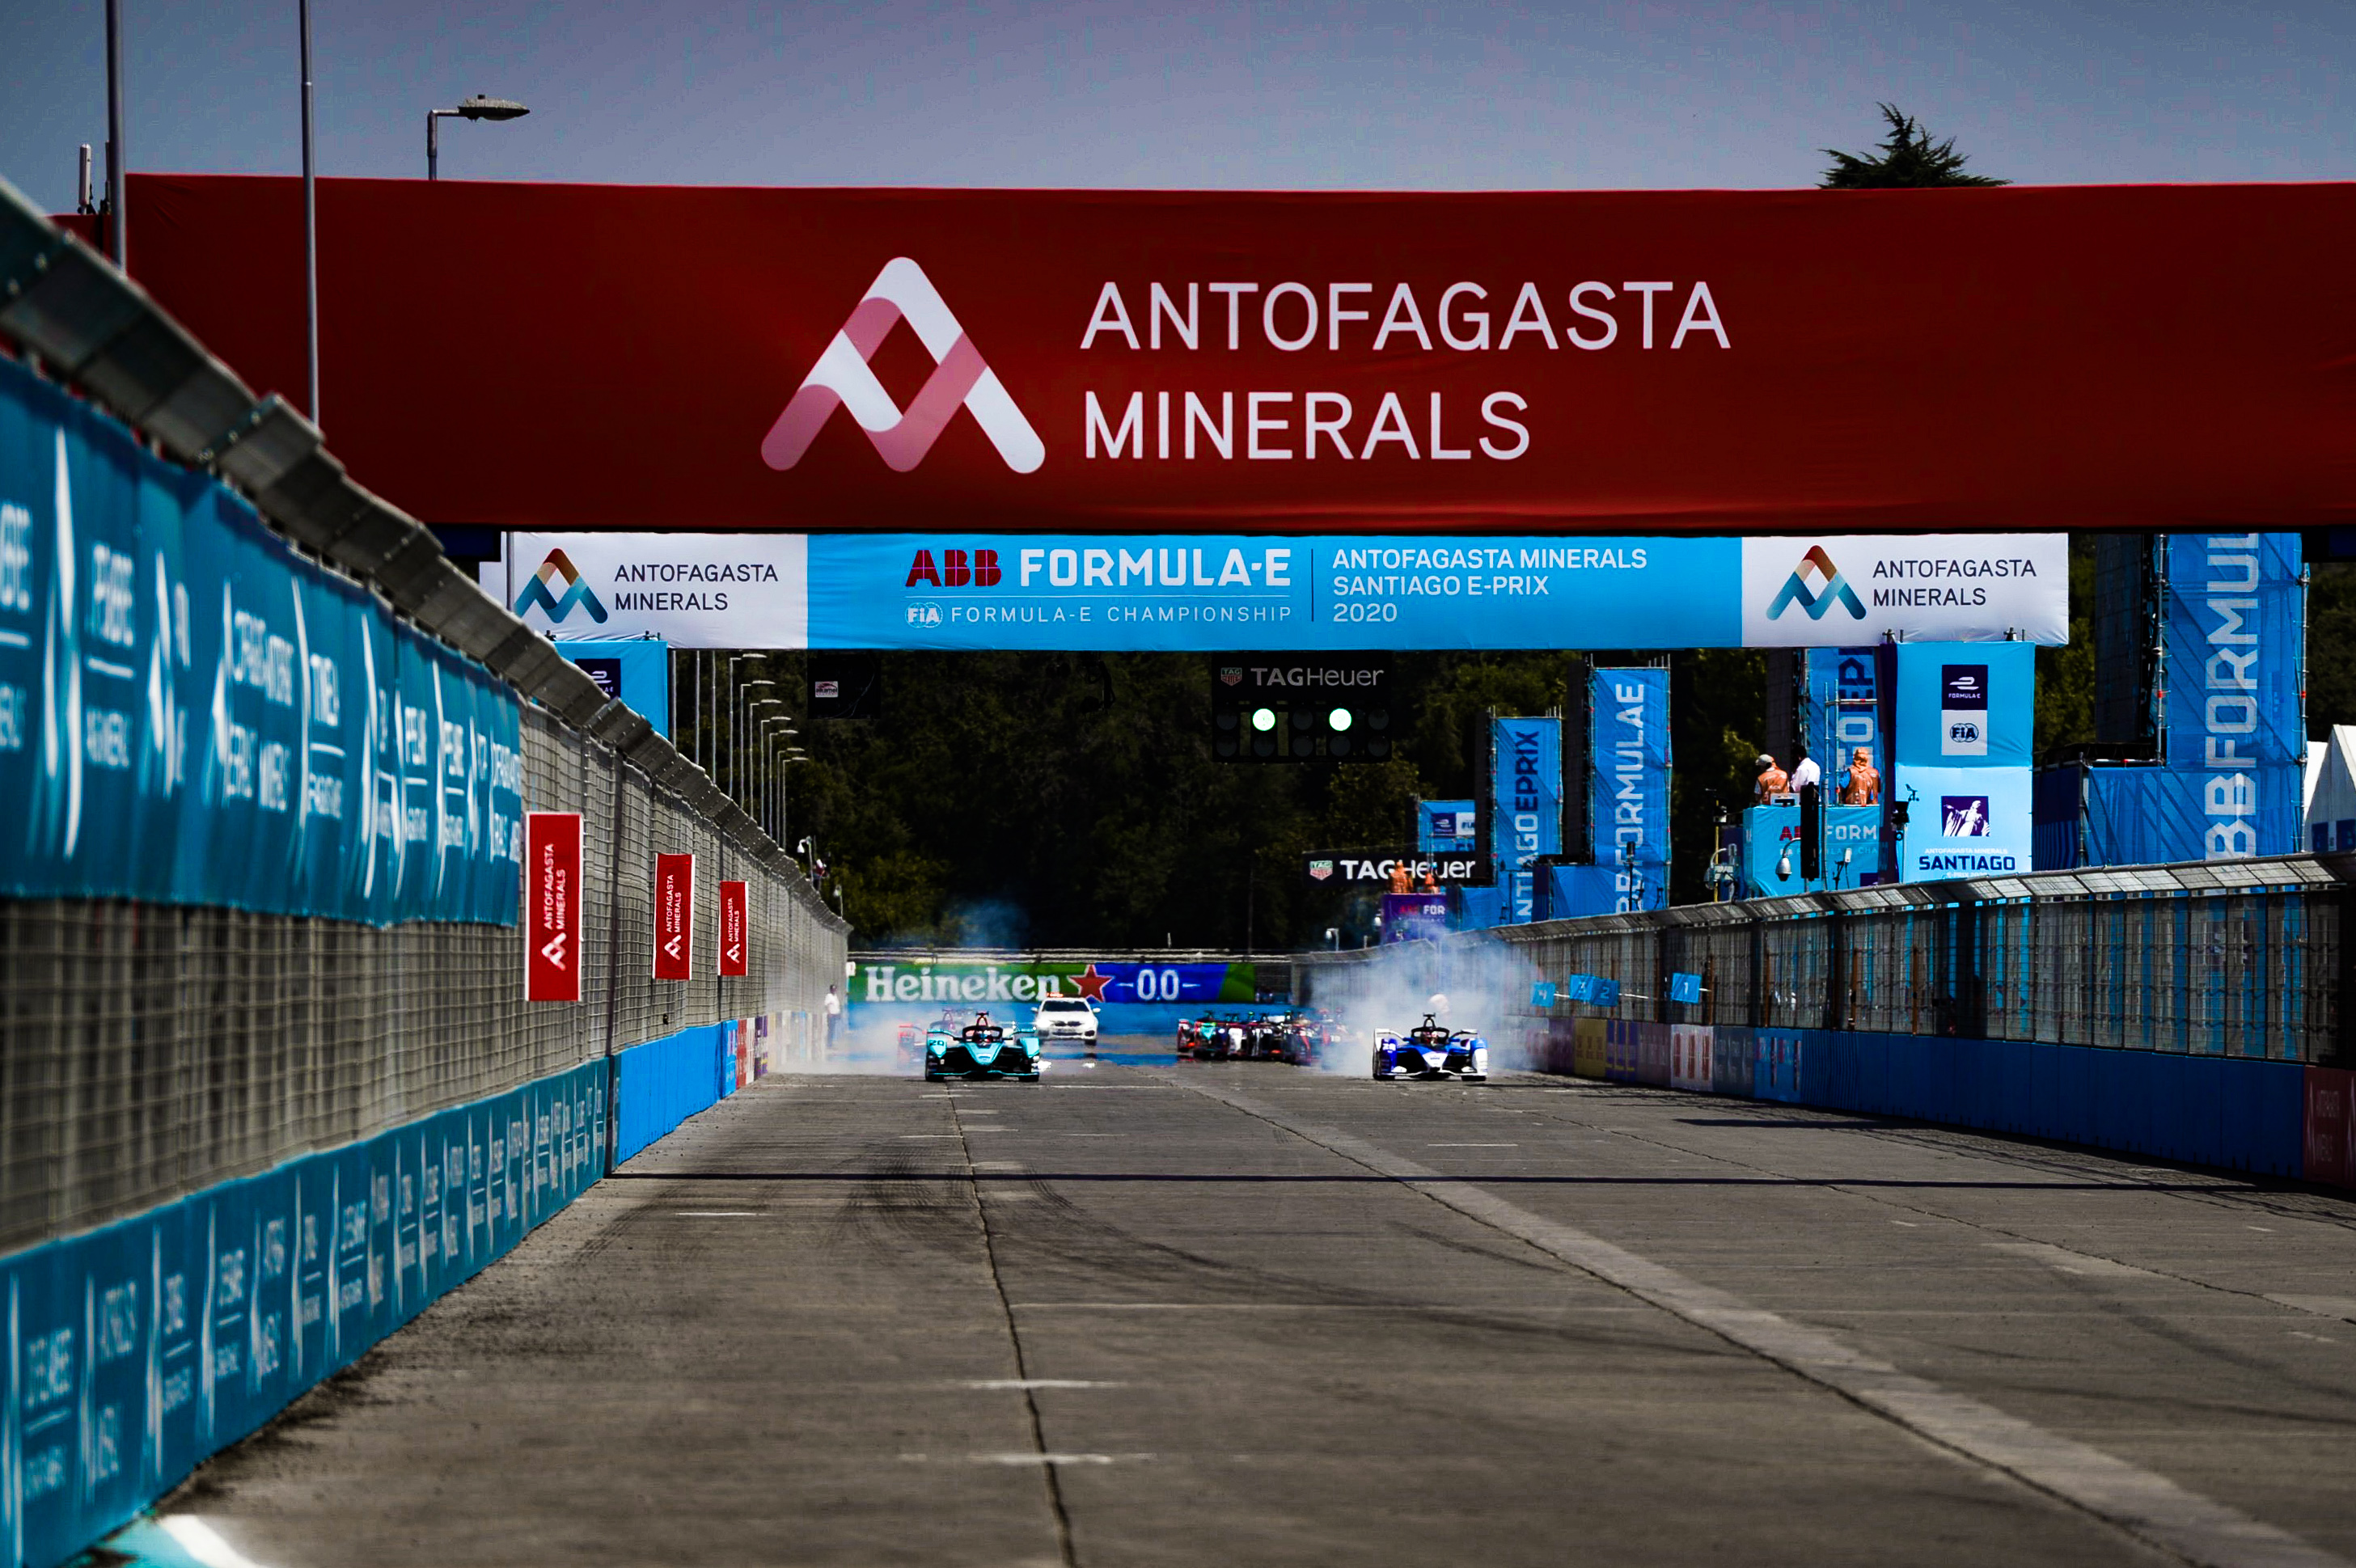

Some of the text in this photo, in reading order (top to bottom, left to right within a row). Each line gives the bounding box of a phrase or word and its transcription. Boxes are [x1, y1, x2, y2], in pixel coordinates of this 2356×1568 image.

[1081, 281, 1731, 351] ANTOFAGASTA
[1085, 391, 1529, 460] MINERALS
[905, 549, 1002, 587] ABB
[1333, 548, 1648, 569] ANTOFAGASTA MINERALS
[1873, 559, 2037, 578] ANTOFAGASTA
[615, 564, 778, 582] ANTOFAGASTA
[1333, 575, 1550, 596] SANTIAGO E-PRIX
[615, 592, 728, 611] MINERALS
[1873, 587, 1986, 606] MINERALS
[951, 607, 1092, 623] FORMULA-E
[1107, 606, 1291, 622] CHAMPIONSHIP
[1333, 602, 1398, 623] 2020
[1918, 855, 2016, 870] SANTIAGO
[544, 843, 554, 930] ANTOFAGASTA
[556, 869, 566, 930] MINERALS
[666, 874, 675, 933] ANTOFAGASTA
[674, 892, 683, 933] MINERALS
[865, 966, 1060, 1002] Heineken
[1683, 982, 1690, 995] 1
